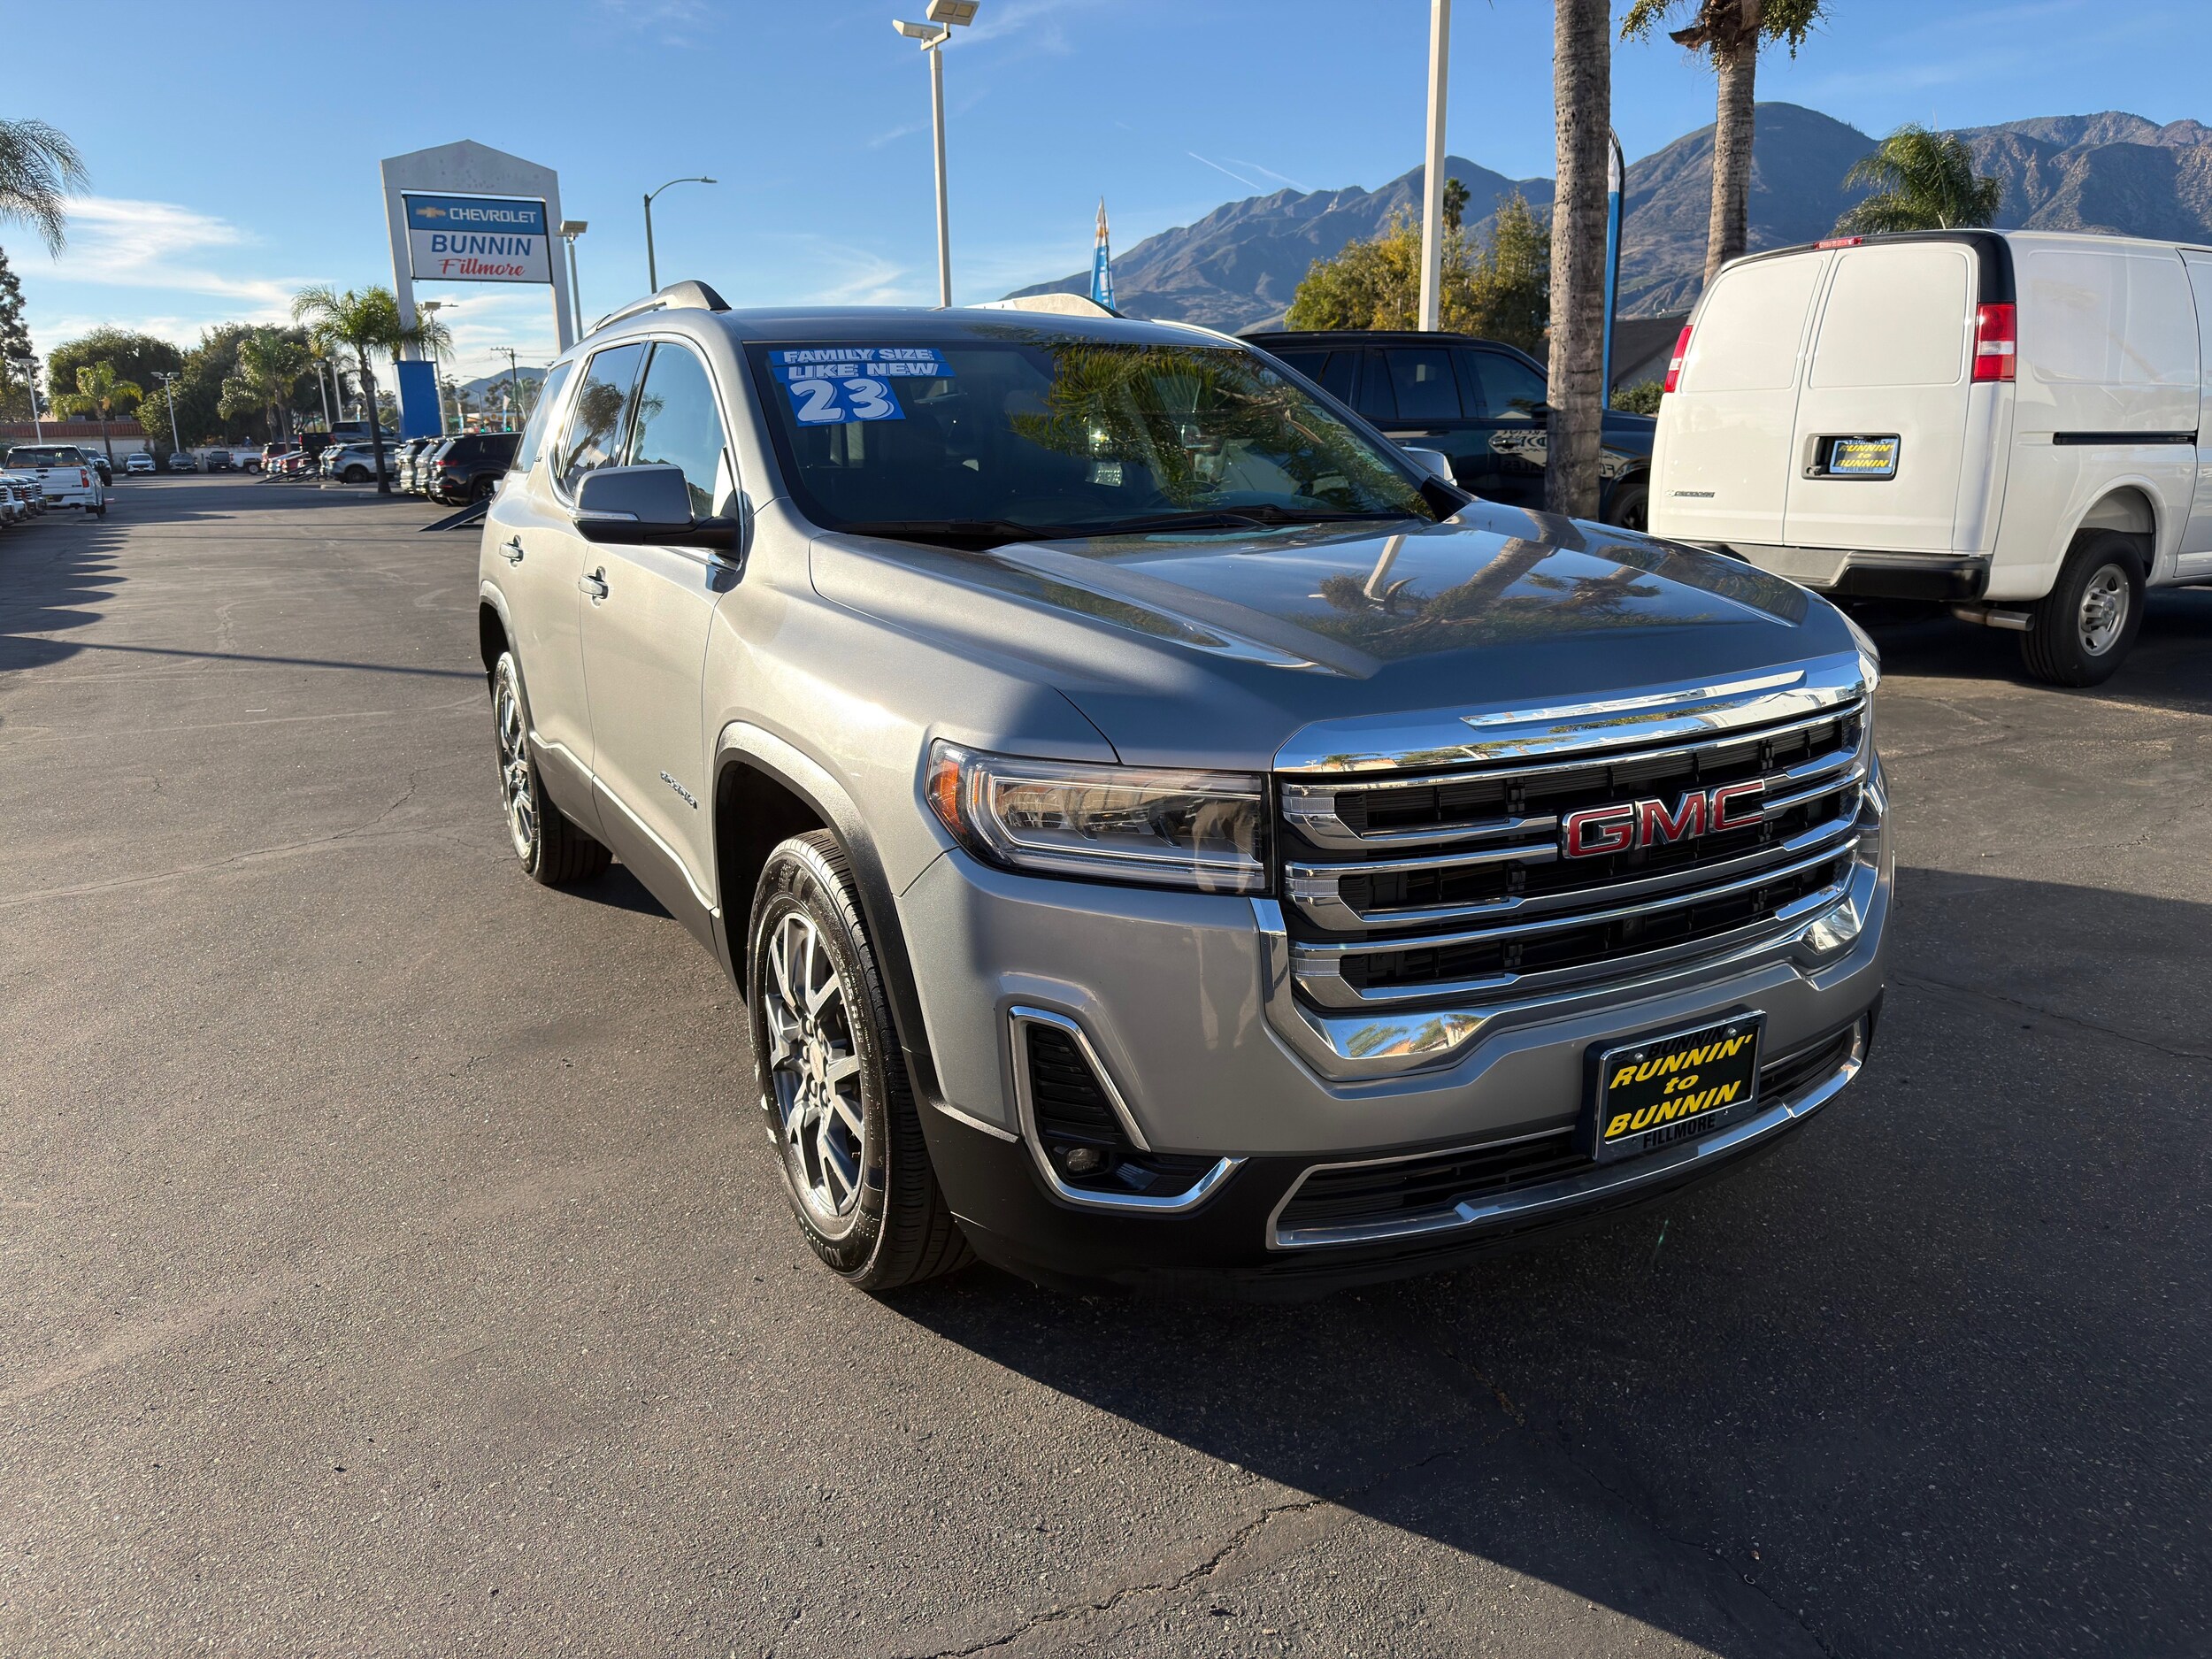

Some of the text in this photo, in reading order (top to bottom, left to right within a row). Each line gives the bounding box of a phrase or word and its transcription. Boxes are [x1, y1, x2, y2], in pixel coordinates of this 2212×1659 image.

[449, 208, 536, 224] CHEVROLET
[431, 234, 532, 256] BUNNIN
[438, 258, 525, 276] Fillmore
[783, 349, 934, 363] FAMILY SIZE
[788, 363, 939, 380] LIKE NEW
[789, 378, 895, 423] 23
[1562, 779, 1766, 859] GMC
[1646, 1024, 1728, 1059] BUNNIN
[1609, 1033, 1754, 1090] RUNNIN'
[1663, 1074, 1700, 1095] to
[1604, 1079, 1742, 1138] BUNNIN
[1643, 1112, 1716, 1148] FILLMORE
